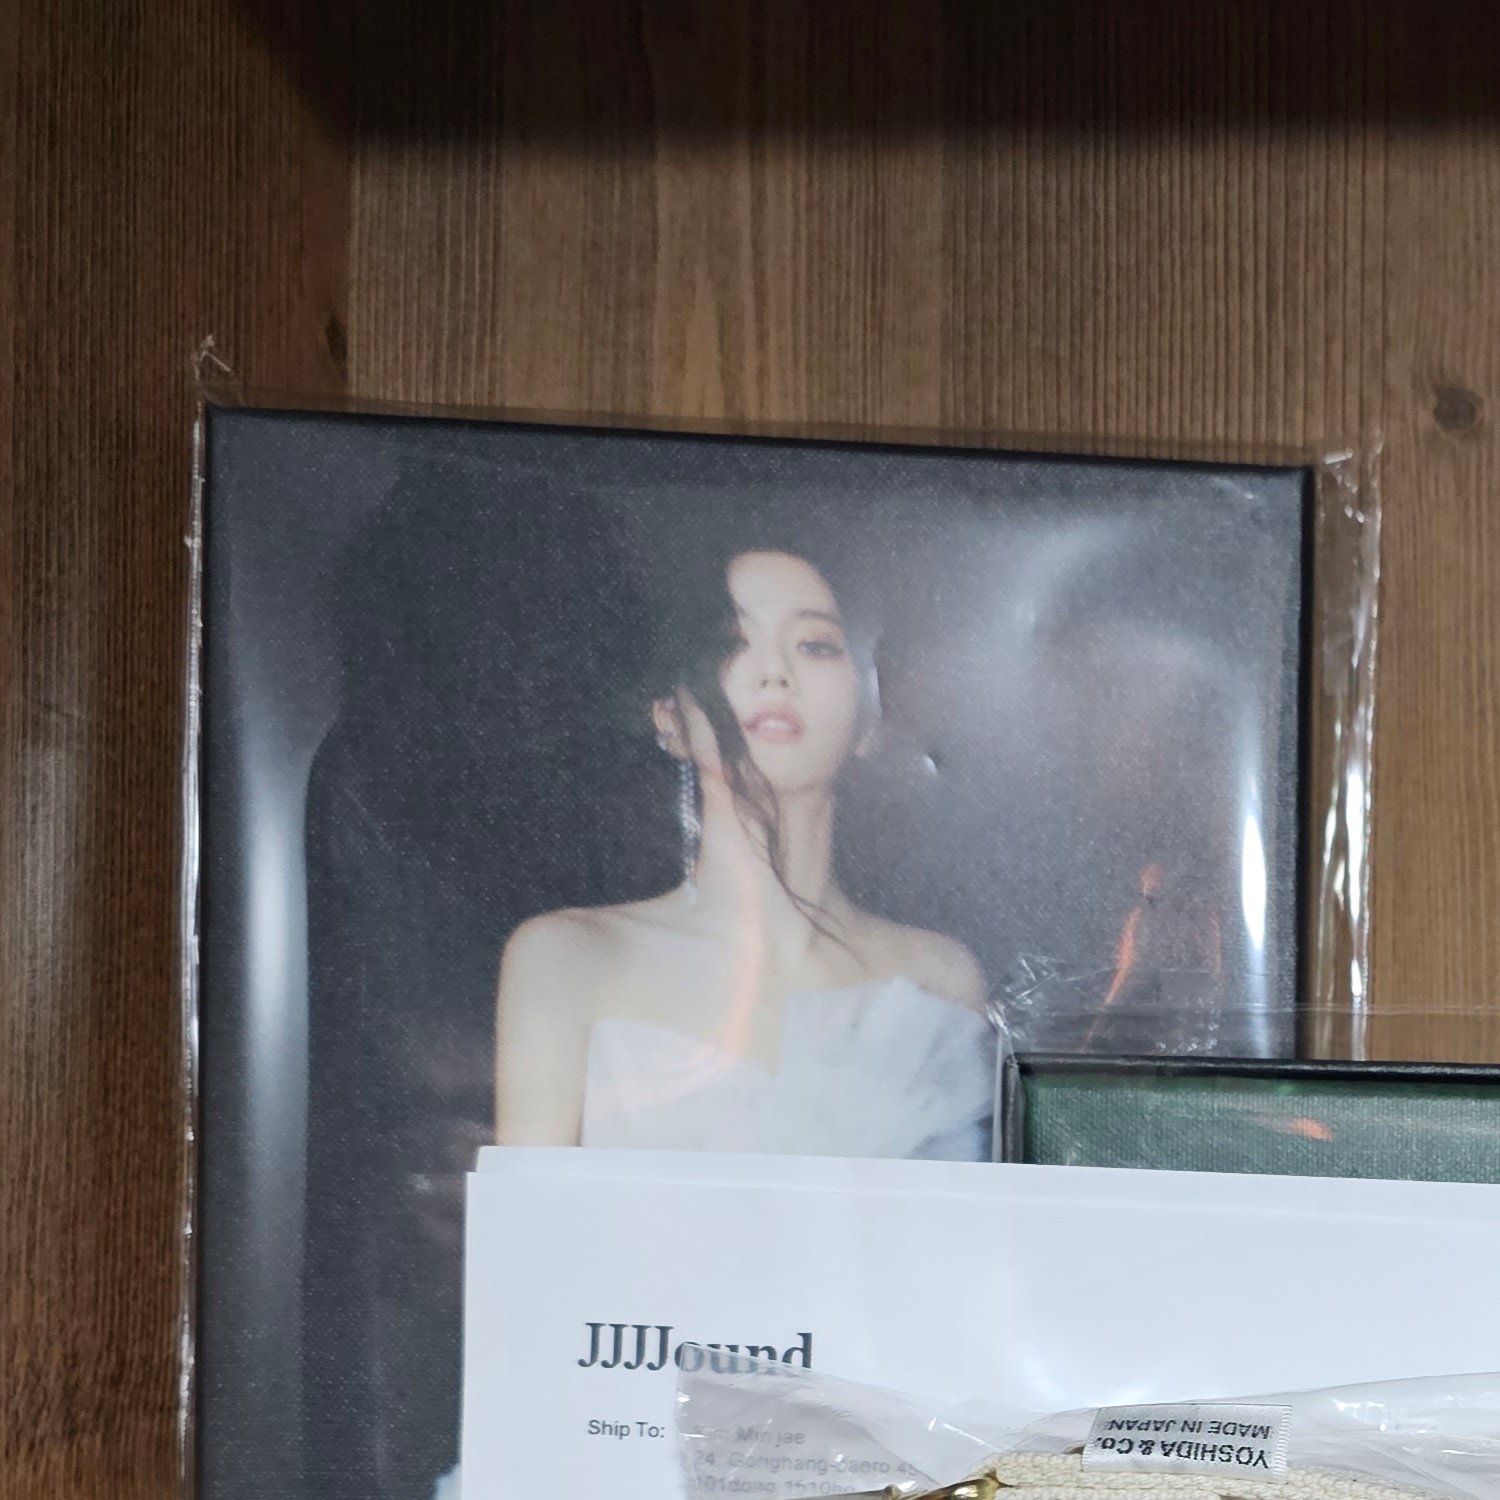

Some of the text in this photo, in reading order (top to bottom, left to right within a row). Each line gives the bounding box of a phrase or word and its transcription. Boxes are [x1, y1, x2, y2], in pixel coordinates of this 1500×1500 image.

[578, 1322, 813, 1373] JJJJound
[588, 1419, 665, 1440] Ship To:
[1106, 1419, 1271, 1439] MADE IN JAPAN
[1140, 1439, 1156, 1455] &
[1161, 1440, 1269, 1468] YOSHIDA
